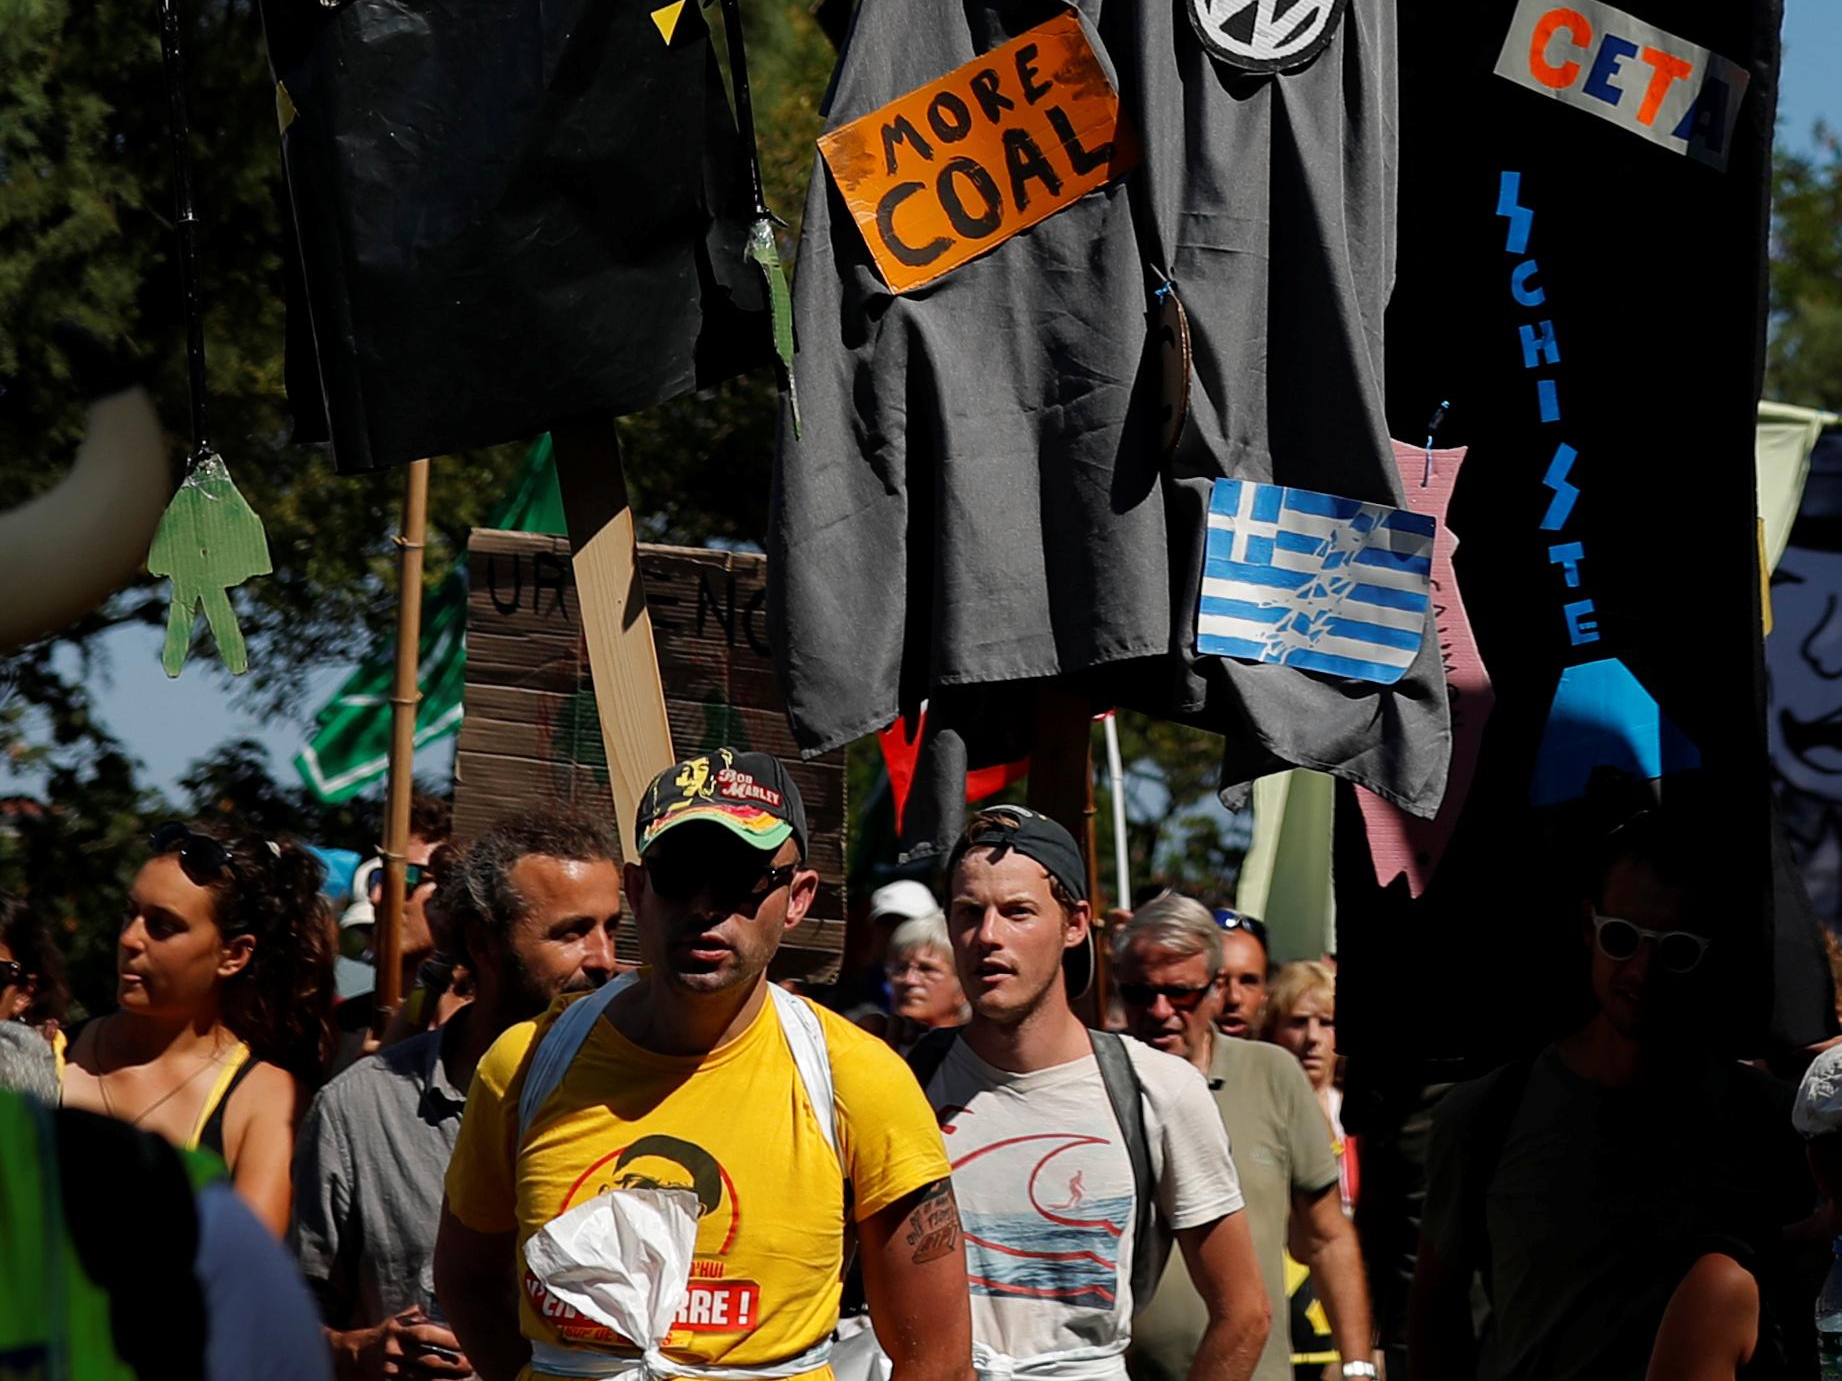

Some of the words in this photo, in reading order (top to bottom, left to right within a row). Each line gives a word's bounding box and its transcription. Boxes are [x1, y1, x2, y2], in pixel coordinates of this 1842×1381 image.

[881, 42, 1053, 177] MORE
[1529, 7, 1731, 154] CETA
[875, 107, 1117, 268] COAL
[722, 782, 781, 805] MARLEY
[672, 1289, 730, 1325] RRE
[738, 1290, 751, 1325] !
